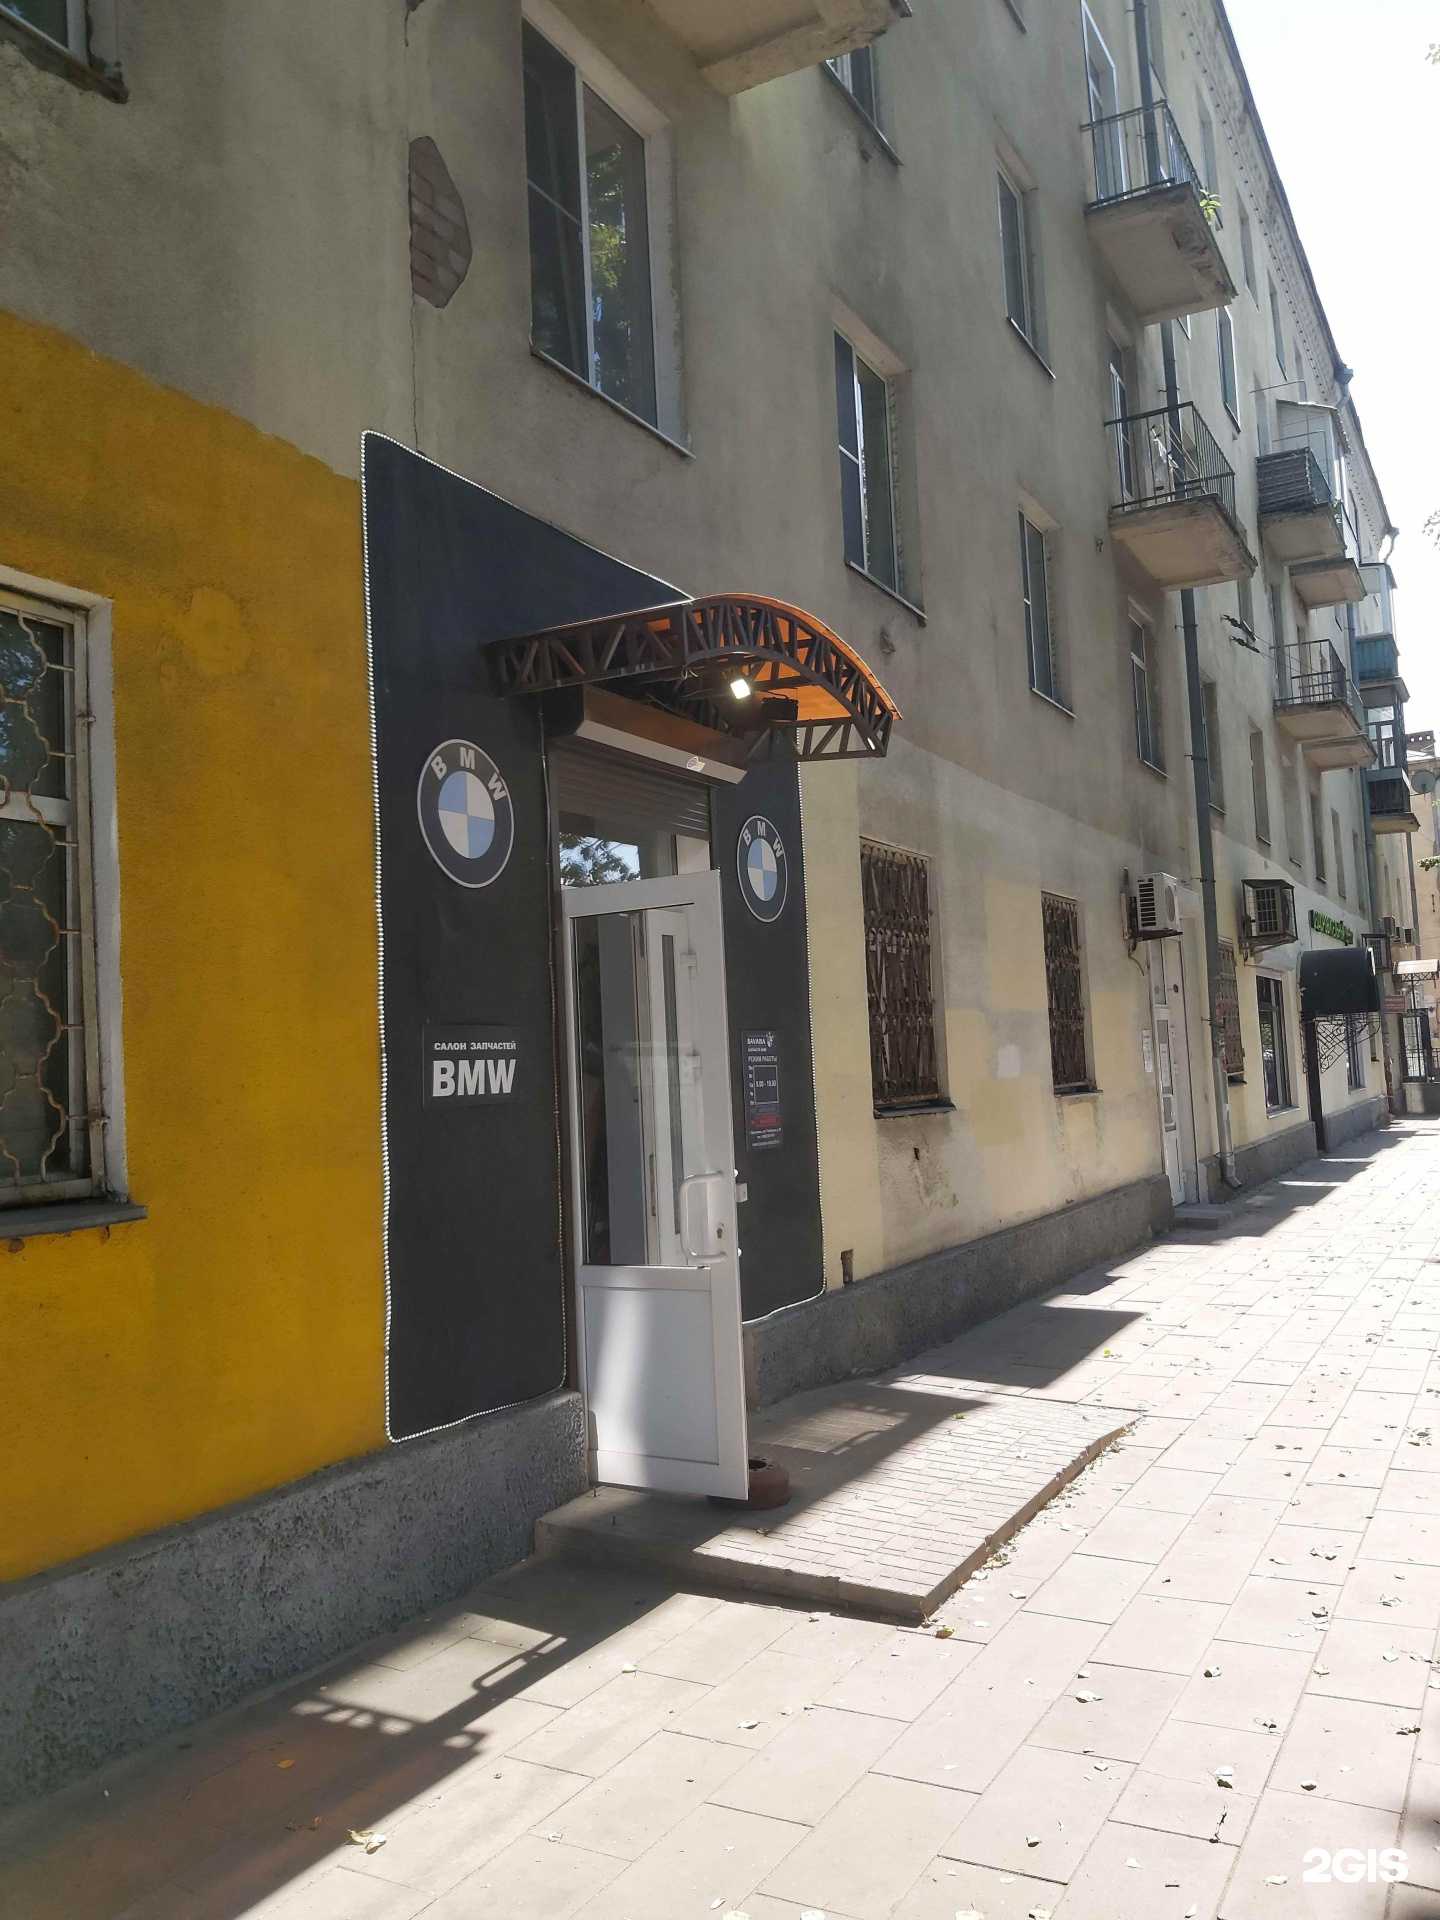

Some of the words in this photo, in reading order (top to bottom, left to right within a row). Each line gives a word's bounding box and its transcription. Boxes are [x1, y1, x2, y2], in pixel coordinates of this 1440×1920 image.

[431, 746, 507, 801] BMW
[743, 820, 784, 858] BMW
[434, 1042, 467, 1050] САЛОН
[470, 1040, 517, 1050] ЗАПЧАСТЕЙ
[432, 1059, 517, 1097] BMW
